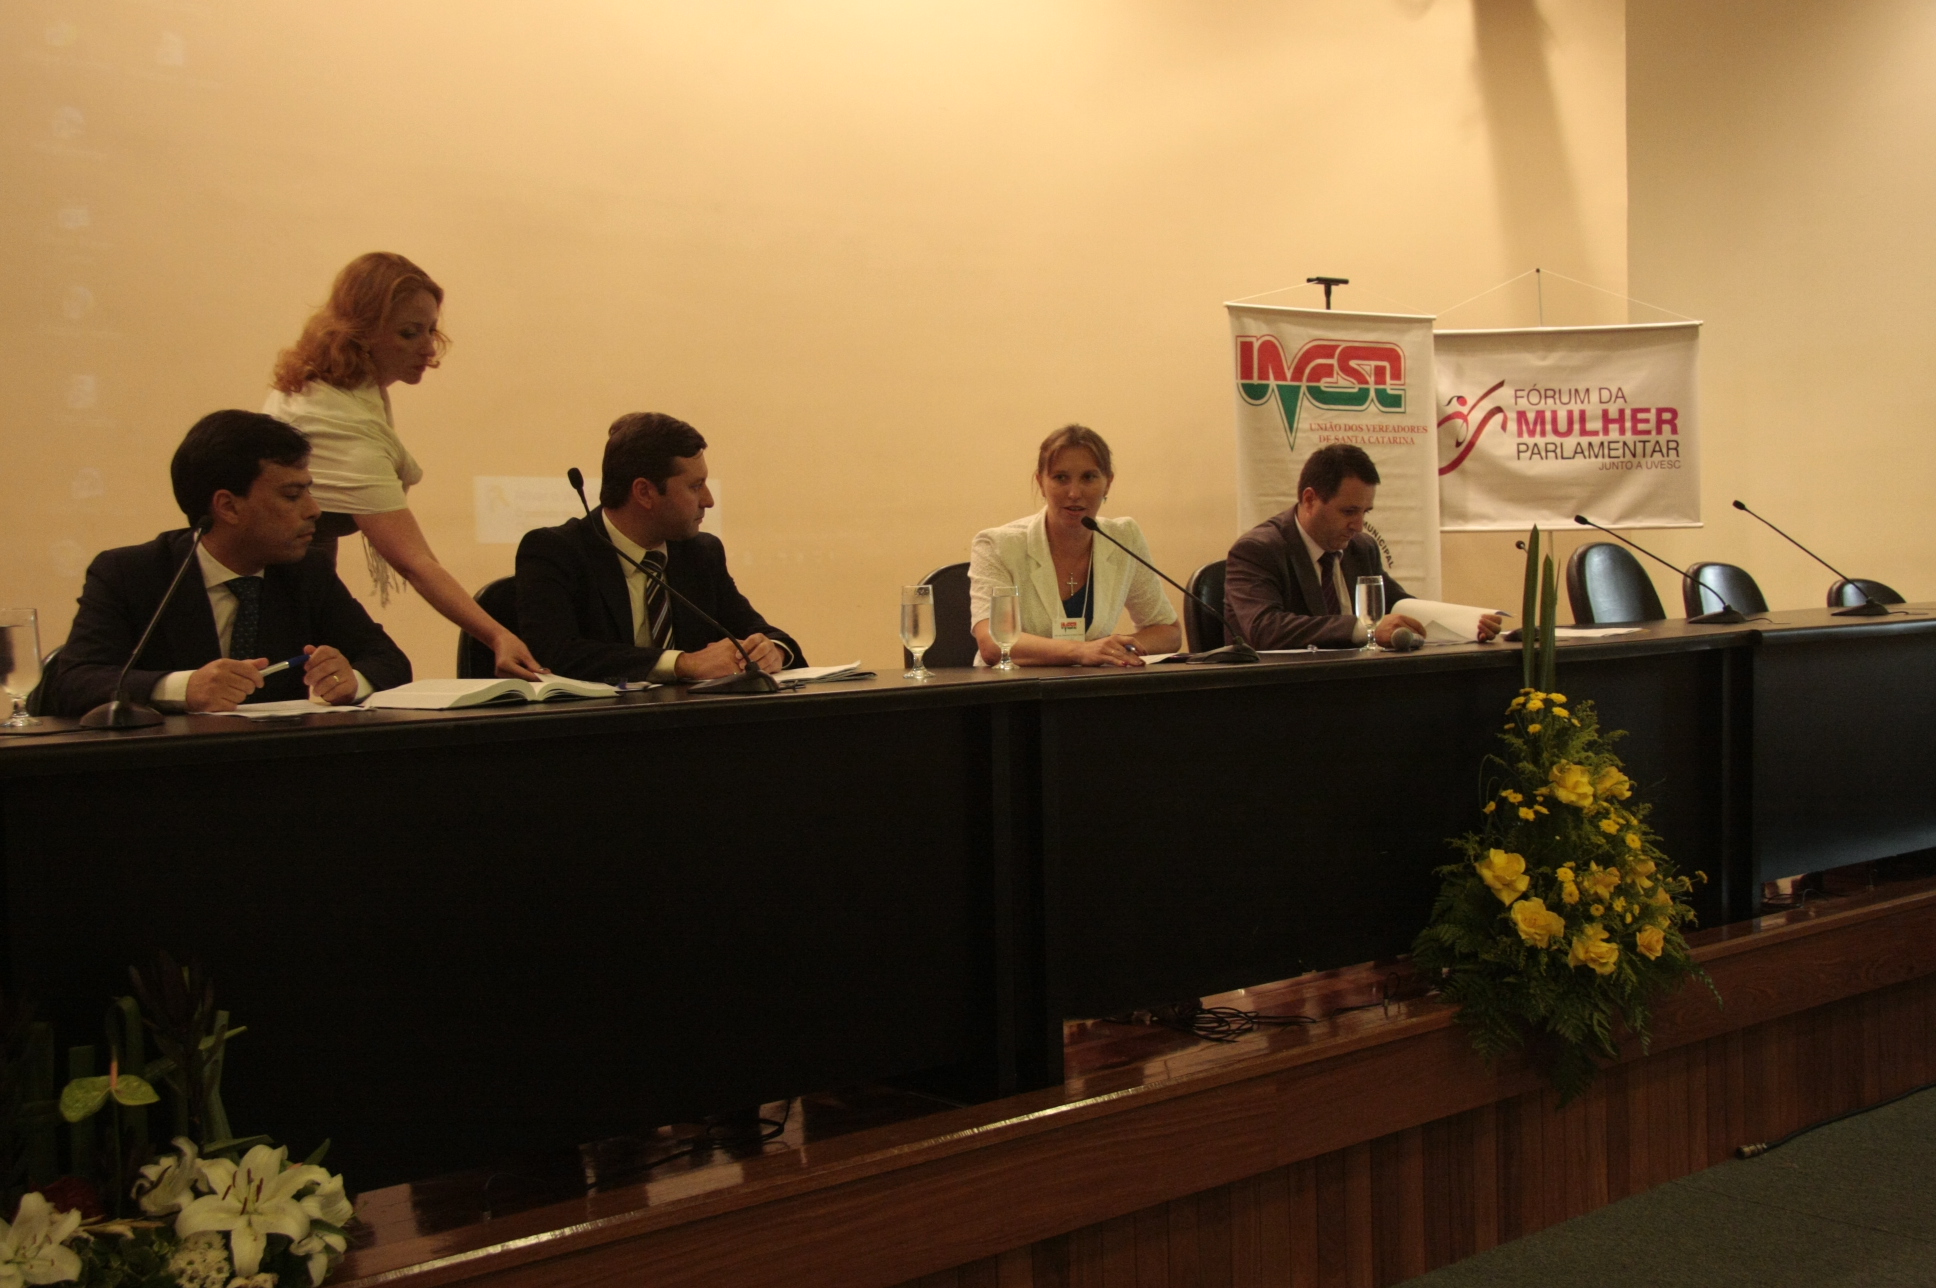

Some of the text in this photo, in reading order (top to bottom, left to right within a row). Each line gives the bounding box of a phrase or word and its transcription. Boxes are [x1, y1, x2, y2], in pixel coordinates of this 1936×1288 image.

[1514, 384, 1628, 405] FÓRUM DA
[1309, 422, 1428, 433] UNIÃO DOS VEREADORES
[1516, 407, 1678, 438] MULHER
[1319, 435, 1415, 445] DE SANTA CATARINA
[1516, 440, 1680, 460] PARLAMENTAR
[1598, 460, 1681, 470] JUNTO A UVESC
